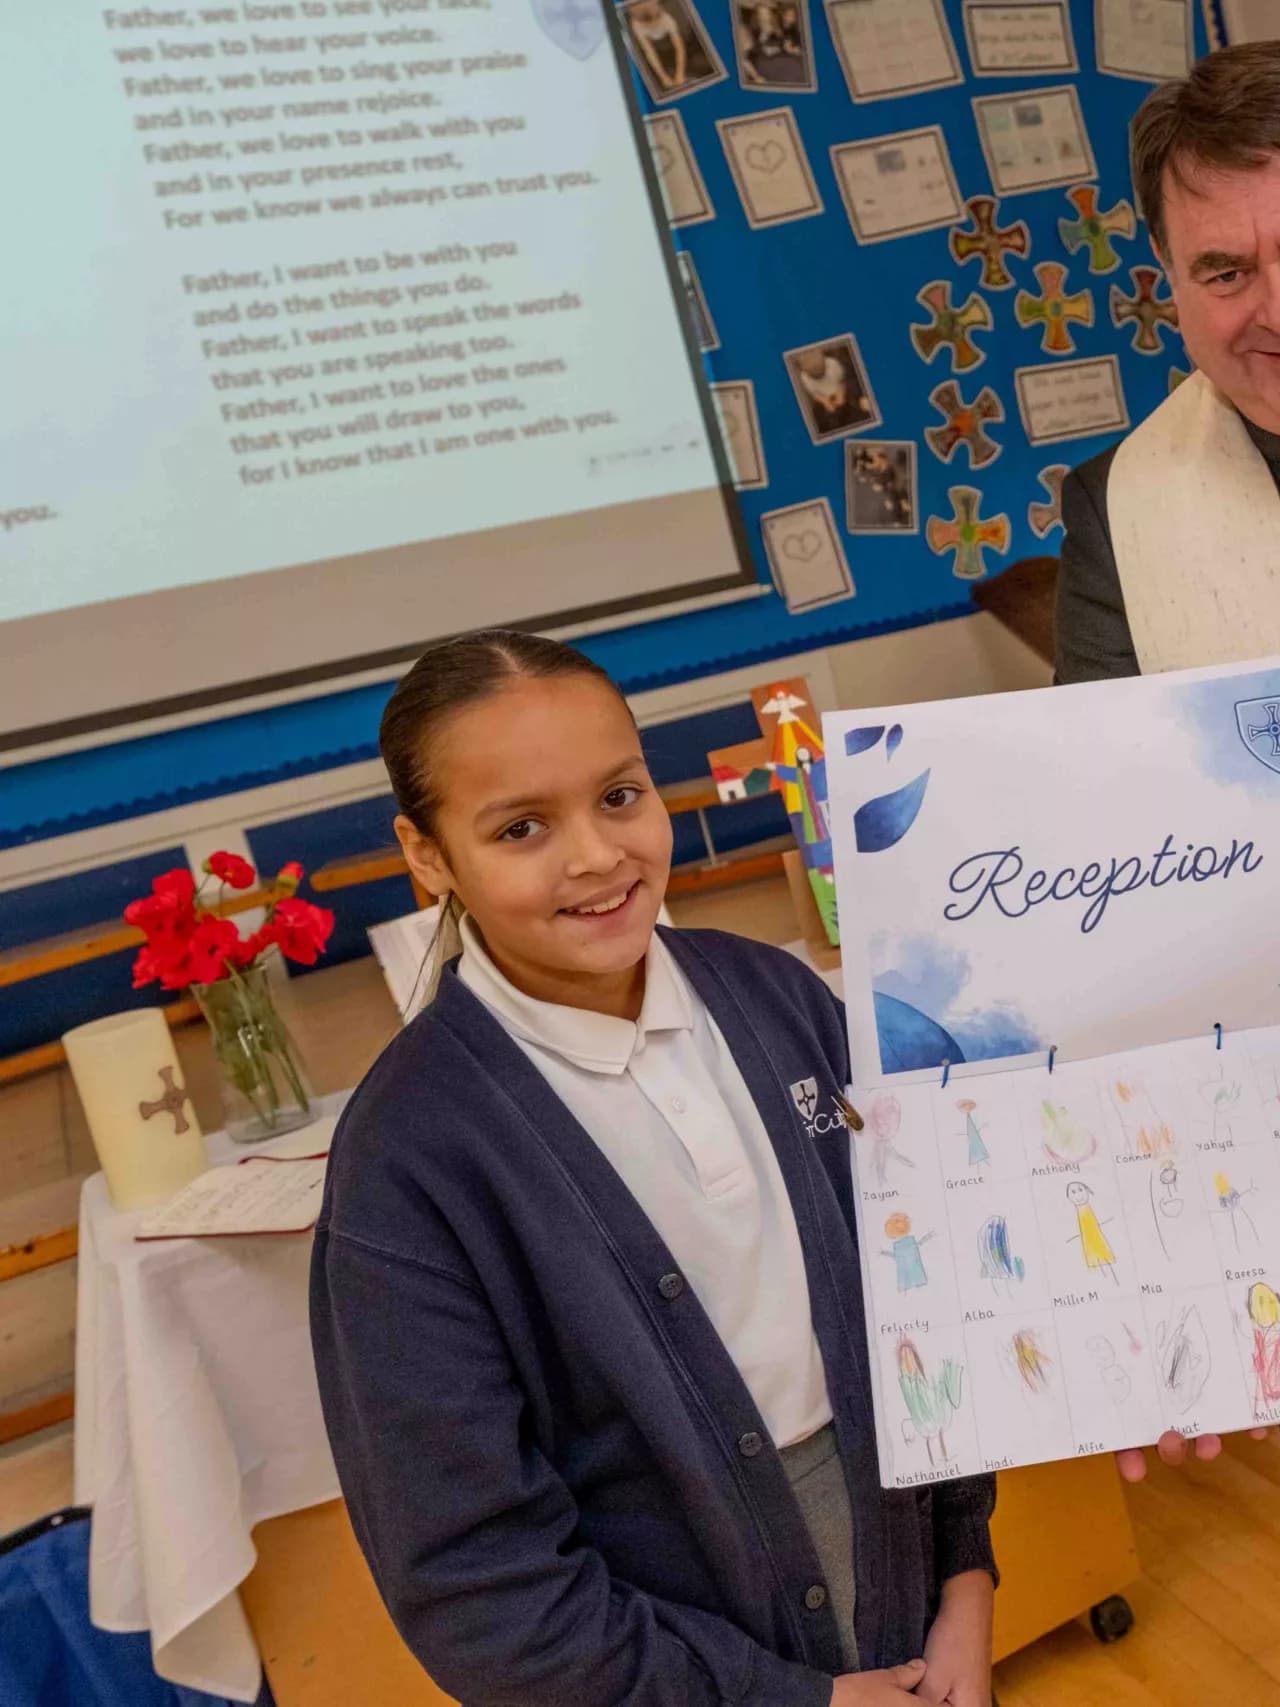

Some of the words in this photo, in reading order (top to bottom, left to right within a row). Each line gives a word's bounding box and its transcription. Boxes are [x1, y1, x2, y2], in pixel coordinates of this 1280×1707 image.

[103, 7, 194, 29] Father,
[200, 8, 237, 24] we
[242, 1, 294, 21] love
[301, 1, 327, 18] to
[333, 0, 371, 15] see
[379, 0, 428, 16] your
[114, 47, 153, 63] we
[158, 38, 214, 59] love
[220, 38, 247, 55] to
[251, 35, 305, 53] hear
[314, 32, 367, 54] your
[375, 26, 442, 45] voice.
[123, 74, 213, 97] Father,
[218, 73, 254, 90] we
[260, 66, 313, 86] love
[318, 64, 345, 82] to
[352, 61, 398, 82] sing
[403, 59, 452, 79] your
[460, 51, 527, 76] praise
[134, 107, 183, 130] and
[188, 106, 214, 126] in
[220, 104, 275, 128] your
[282, 99, 349, 118] name
[357, 91, 442, 113] rejoice.
[143, 141, 232, 164] Father,
[237, 139, 274, 154] we
[279, 132, 331, 151] love
[336, 129, 362, 146] to
[369, 121, 423, 143] walk
[428, 117, 478, 138] with
[483, 116, 526, 136] you
[154, 173, 202, 197] and
[207, 172, 233, 191] in
[238, 169, 293, 192] your
[301, 160, 405, 186] presence
[412, 152, 463, 172] rest,
[164, 208, 203, 230] For
[211, 207, 247, 224] we
[252, 199, 322, 220] know
[327, 195, 362, 212] we
[370, 186, 447, 208] always
[453, 181, 491, 200] can
[496, 173, 548, 194] trust
[552, 171, 600, 193] you.
[182, 270, 270, 295] Father,
[274, 264, 283, 284] I
[288, 260, 349, 281] want
[354, 257, 380, 274] to
[383, 250, 414, 270] be
[419, 244, 470, 265] with
[475, 242, 518, 263] you
[193, 303, 240, 327] and
[246, 300, 278, 320] do
[283, 294, 324, 315] the
[329, 287, 402, 308] things
[406, 282, 449, 303] you
[454, 273, 492, 293] do.
[202, 333, 288, 358] Father,
[292, 328, 300, 347] I
[306, 321, 367, 344] want
[372, 319, 398, 336] to
[403, 306, 468, 334] speak
[473, 301, 510, 322] the
[515, 290, 582, 316] words
[211, 368, 264, 391] that
[268, 363, 315, 387] you
[320, 357, 358, 375] are
[364, 341, 467, 371] speaking
[468, 336, 515, 352] too.
[219, 397, 305, 423] Father,
[310, 392, 320, 409] I
[324, 383, 385, 406] want
[389, 380, 414, 397] to
[417, 373, 467, 393] love
[472, 363, 510, 384] the
[514, 358, 567, 378] ones
[229, 430, 281, 454] that
[286, 424, 333, 448] you
[336, 412, 380, 436] will
[385, 409, 443, 430] draw
[447, 402, 472, 418] to
[239, 464, 274, 486] for
[281, 460, 290, 480] I
[294, 453, 362, 476] know
[366, 442, 415, 465] that
[434, 435, 470, 453] am
[474, 427, 516, 446] one
[520, 415, 569, 437] with
[574, 410, 619, 432] you.
[944, 834, 1263, 933] Reception
[1195, 1140, 1234, 1152] Yahya
[946, 1175, 985, 1189] Gracie
[1031, 1162, 1081, 1176] Anthony
[863, 1188, 899, 1201] Zayan
[1053, 1294, 1085, 1307] Millie
[1088, 1292, 1099, 1302] M
[1141, 1284, 1162, 1294] Mia
[881, 1318, 929, 1335] Felicity
[964, 1309, 995, 1322] Alba
[985, 1457, 1015, 1470] Hadi
[1078, 1441, 1105, 1454] Alfie
[896, 1464, 961, 1486] Nathaniel
